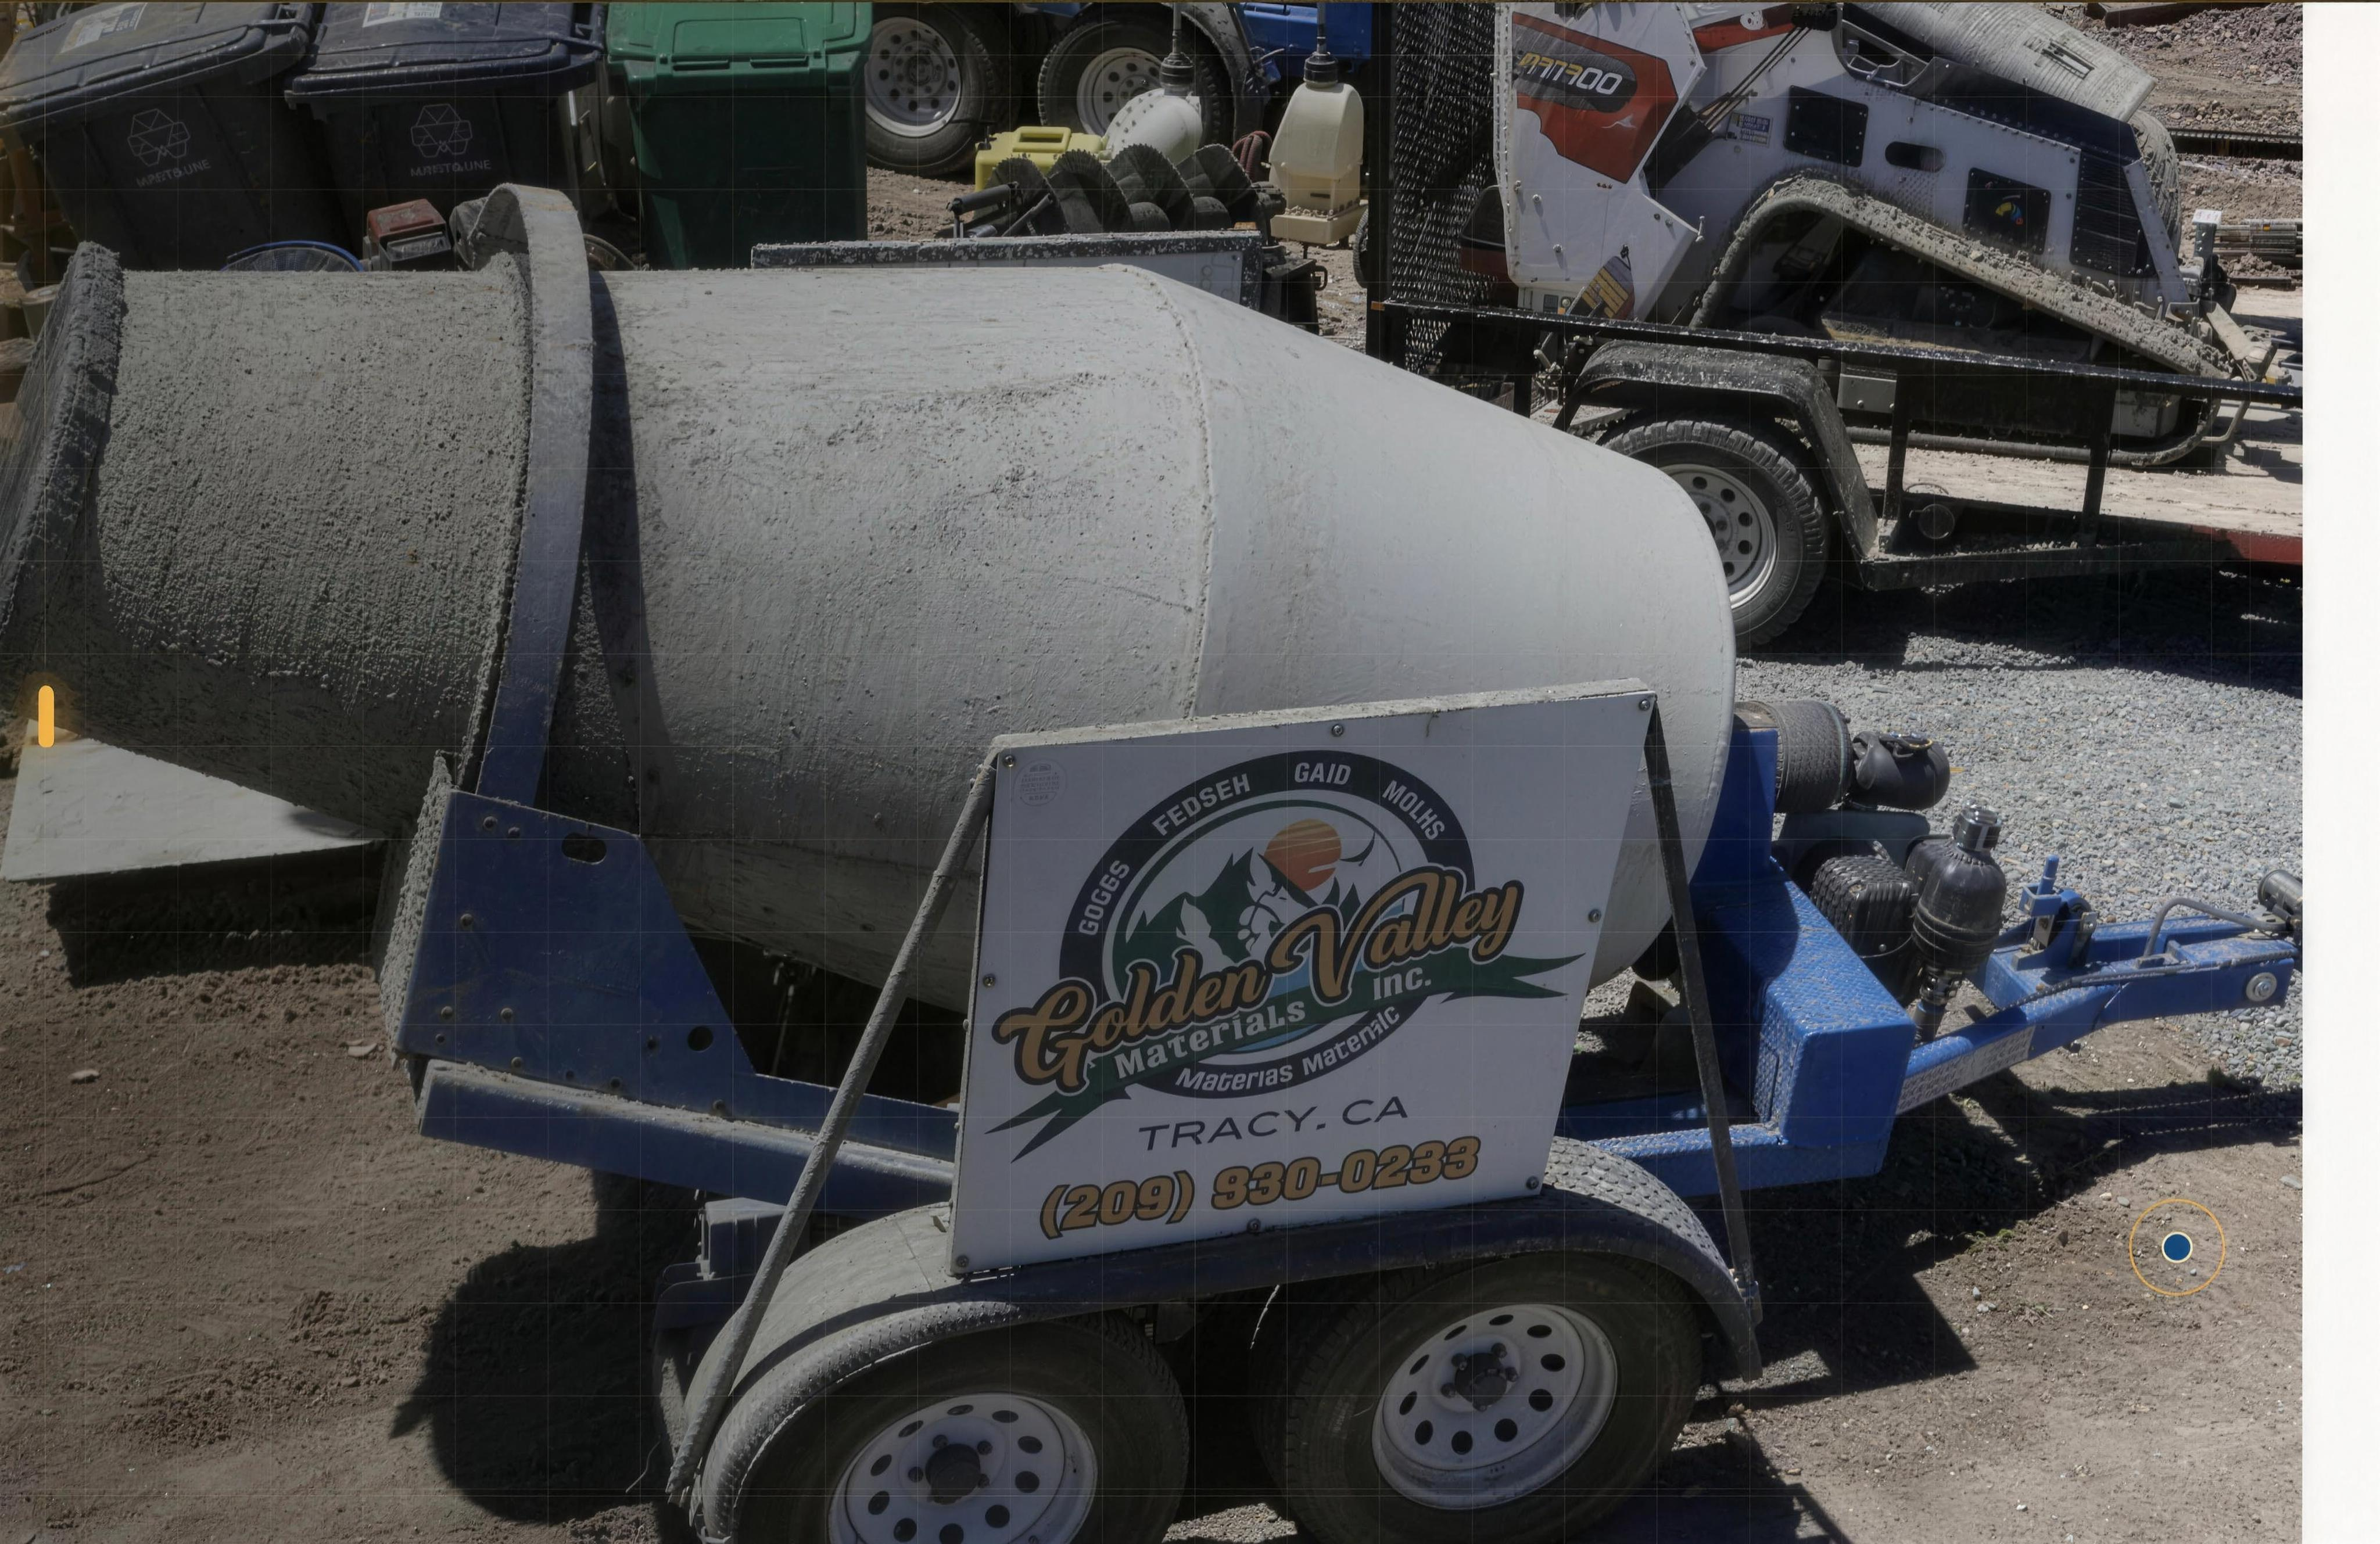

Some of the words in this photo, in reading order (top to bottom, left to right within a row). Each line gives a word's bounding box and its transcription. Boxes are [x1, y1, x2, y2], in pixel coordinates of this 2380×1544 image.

[1293, 762, 1352, 785] GAID
[997, 953, 1264, 1090] Golden
[1271, 870, 1521, 1000] Valley
[1342, 1096, 1408, 1125] CA
[1040, 1170, 1196, 1240] (209)
[1210, 1136, 1482, 1209] 930-0233
